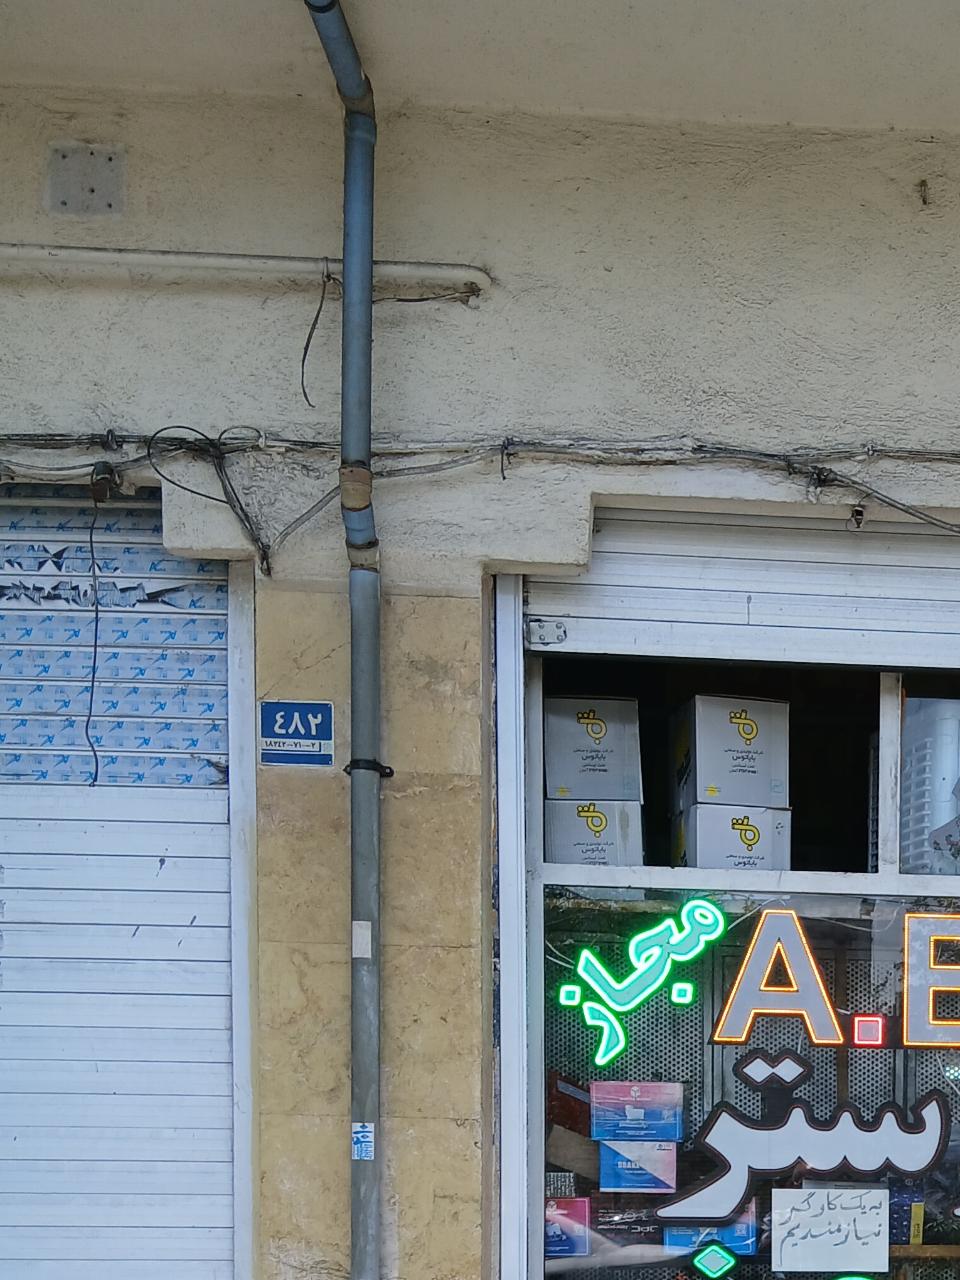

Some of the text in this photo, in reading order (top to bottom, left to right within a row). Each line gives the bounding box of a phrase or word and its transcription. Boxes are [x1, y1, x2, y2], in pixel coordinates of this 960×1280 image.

[778, 1191, 883, 1226] به یک کارگر
[778, 1217, 883, 1268] نیازمندیم
